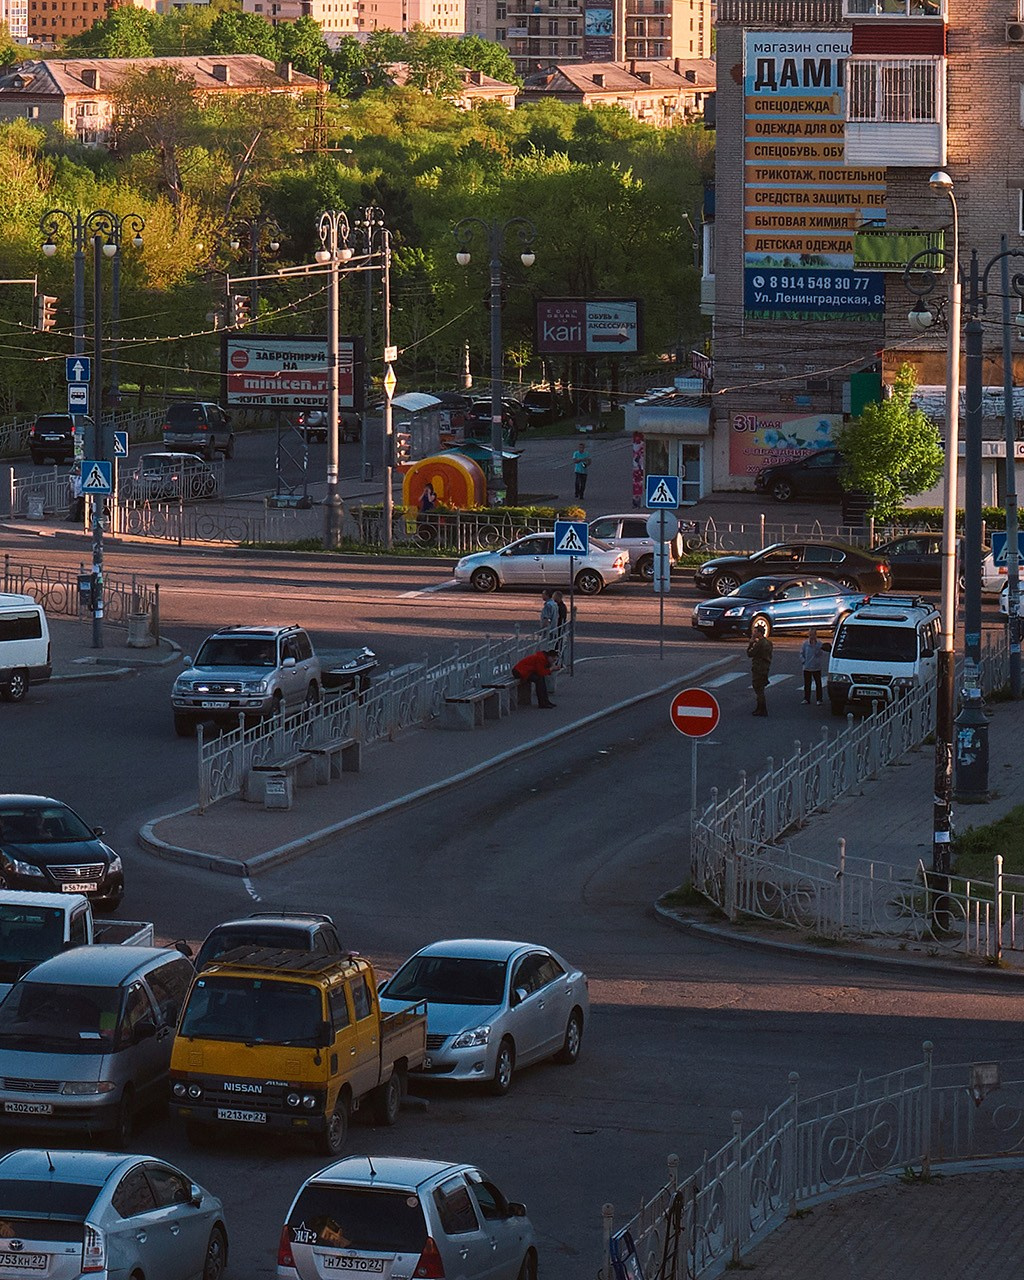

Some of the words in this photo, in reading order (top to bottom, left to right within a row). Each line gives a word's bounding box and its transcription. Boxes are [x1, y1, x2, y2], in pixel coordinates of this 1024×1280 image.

[754, 43, 811, 53] магазин
[754, 100, 830, 113] СПЕЦОДЕЖДА
[755, 123, 804, 135] ОДЕЖДА
[804, 124, 827, 135] ДЛЯ
[755, 169, 816, 181] ТРИКОТАЖ,
[755, 192, 810, 204] СРЕДСТВА
[755, 216, 806, 227] БЫТОВАЯ
[809, 217, 848, 228] ХИМИЯ
[755, 239, 803, 251] ДЕТСКАЯ
[806, 241, 853, 252] ОДЕЖДА
[770, 276, 778, 288] 8
[781, 276, 805, 288] 914
[807, 277, 831, 289] 548
[835, 278, 850, 290] 30
[853, 278, 870, 290] 77
[754, 292, 772, 302] Ул.
[775, 293, 871, 306] Ленинградская,
[543, 320, 582, 341] kari
[255, 351, 326, 361] ЗАБРОНИРУЙ
[283, 362, 298, 370] НА
[271, 396, 289, 404] ВНЕ
[733, 415, 758, 432] 31
[759, 420, 782, 429] МАЯ
[223, 1082, 263, 1094] NISSAN
